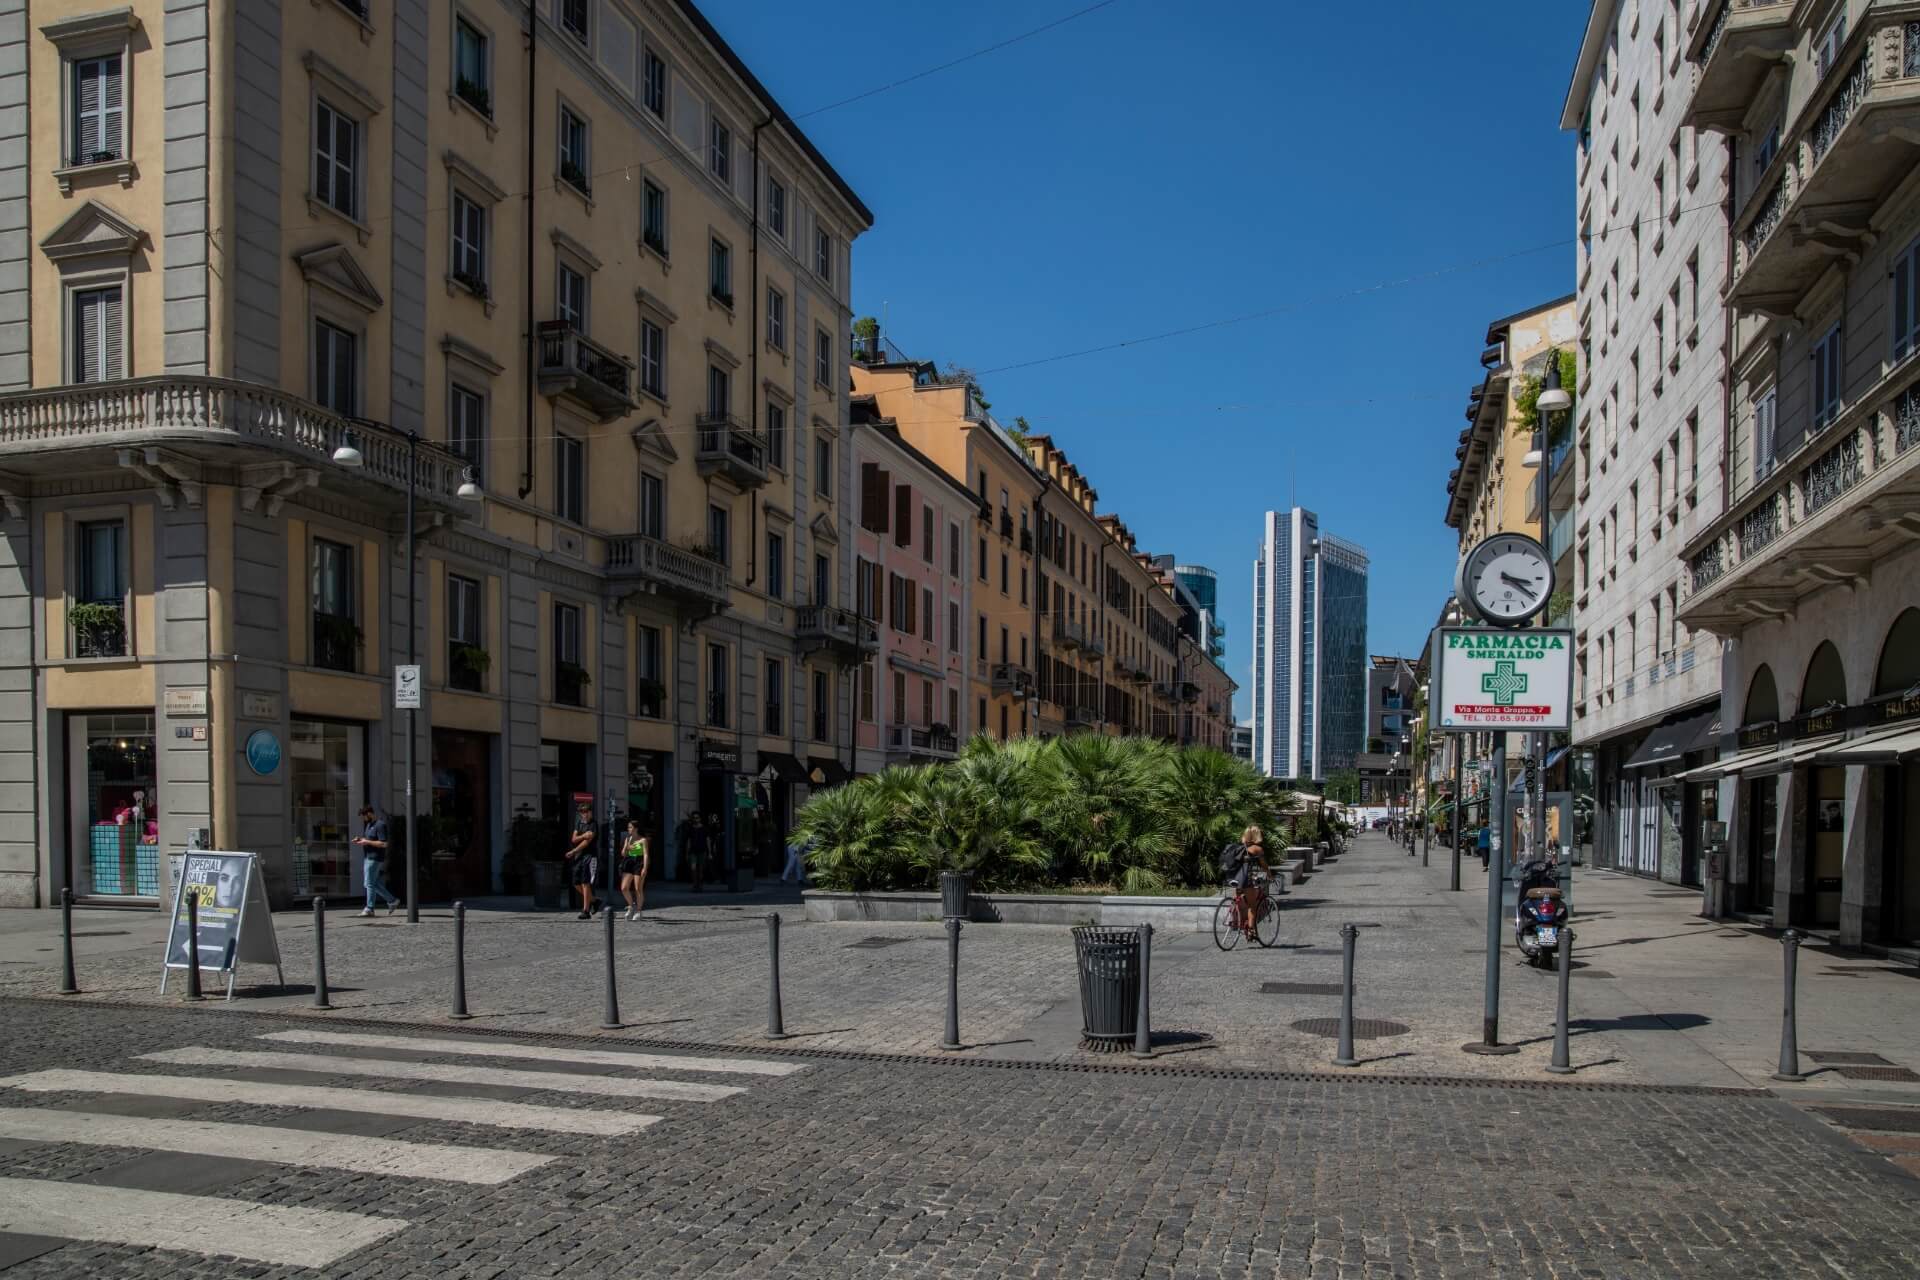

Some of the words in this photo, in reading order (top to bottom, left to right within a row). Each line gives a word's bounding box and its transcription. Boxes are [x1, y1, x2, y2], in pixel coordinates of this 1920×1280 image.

[1448, 635, 1564, 649] FARMACIA
[1467, 650, 1544, 659] SMERALDO
[1503, 706, 1535, 714] Grappa,
[190, 859, 220, 871] SPECIAL
[187, 871, 206, 884] SALE
